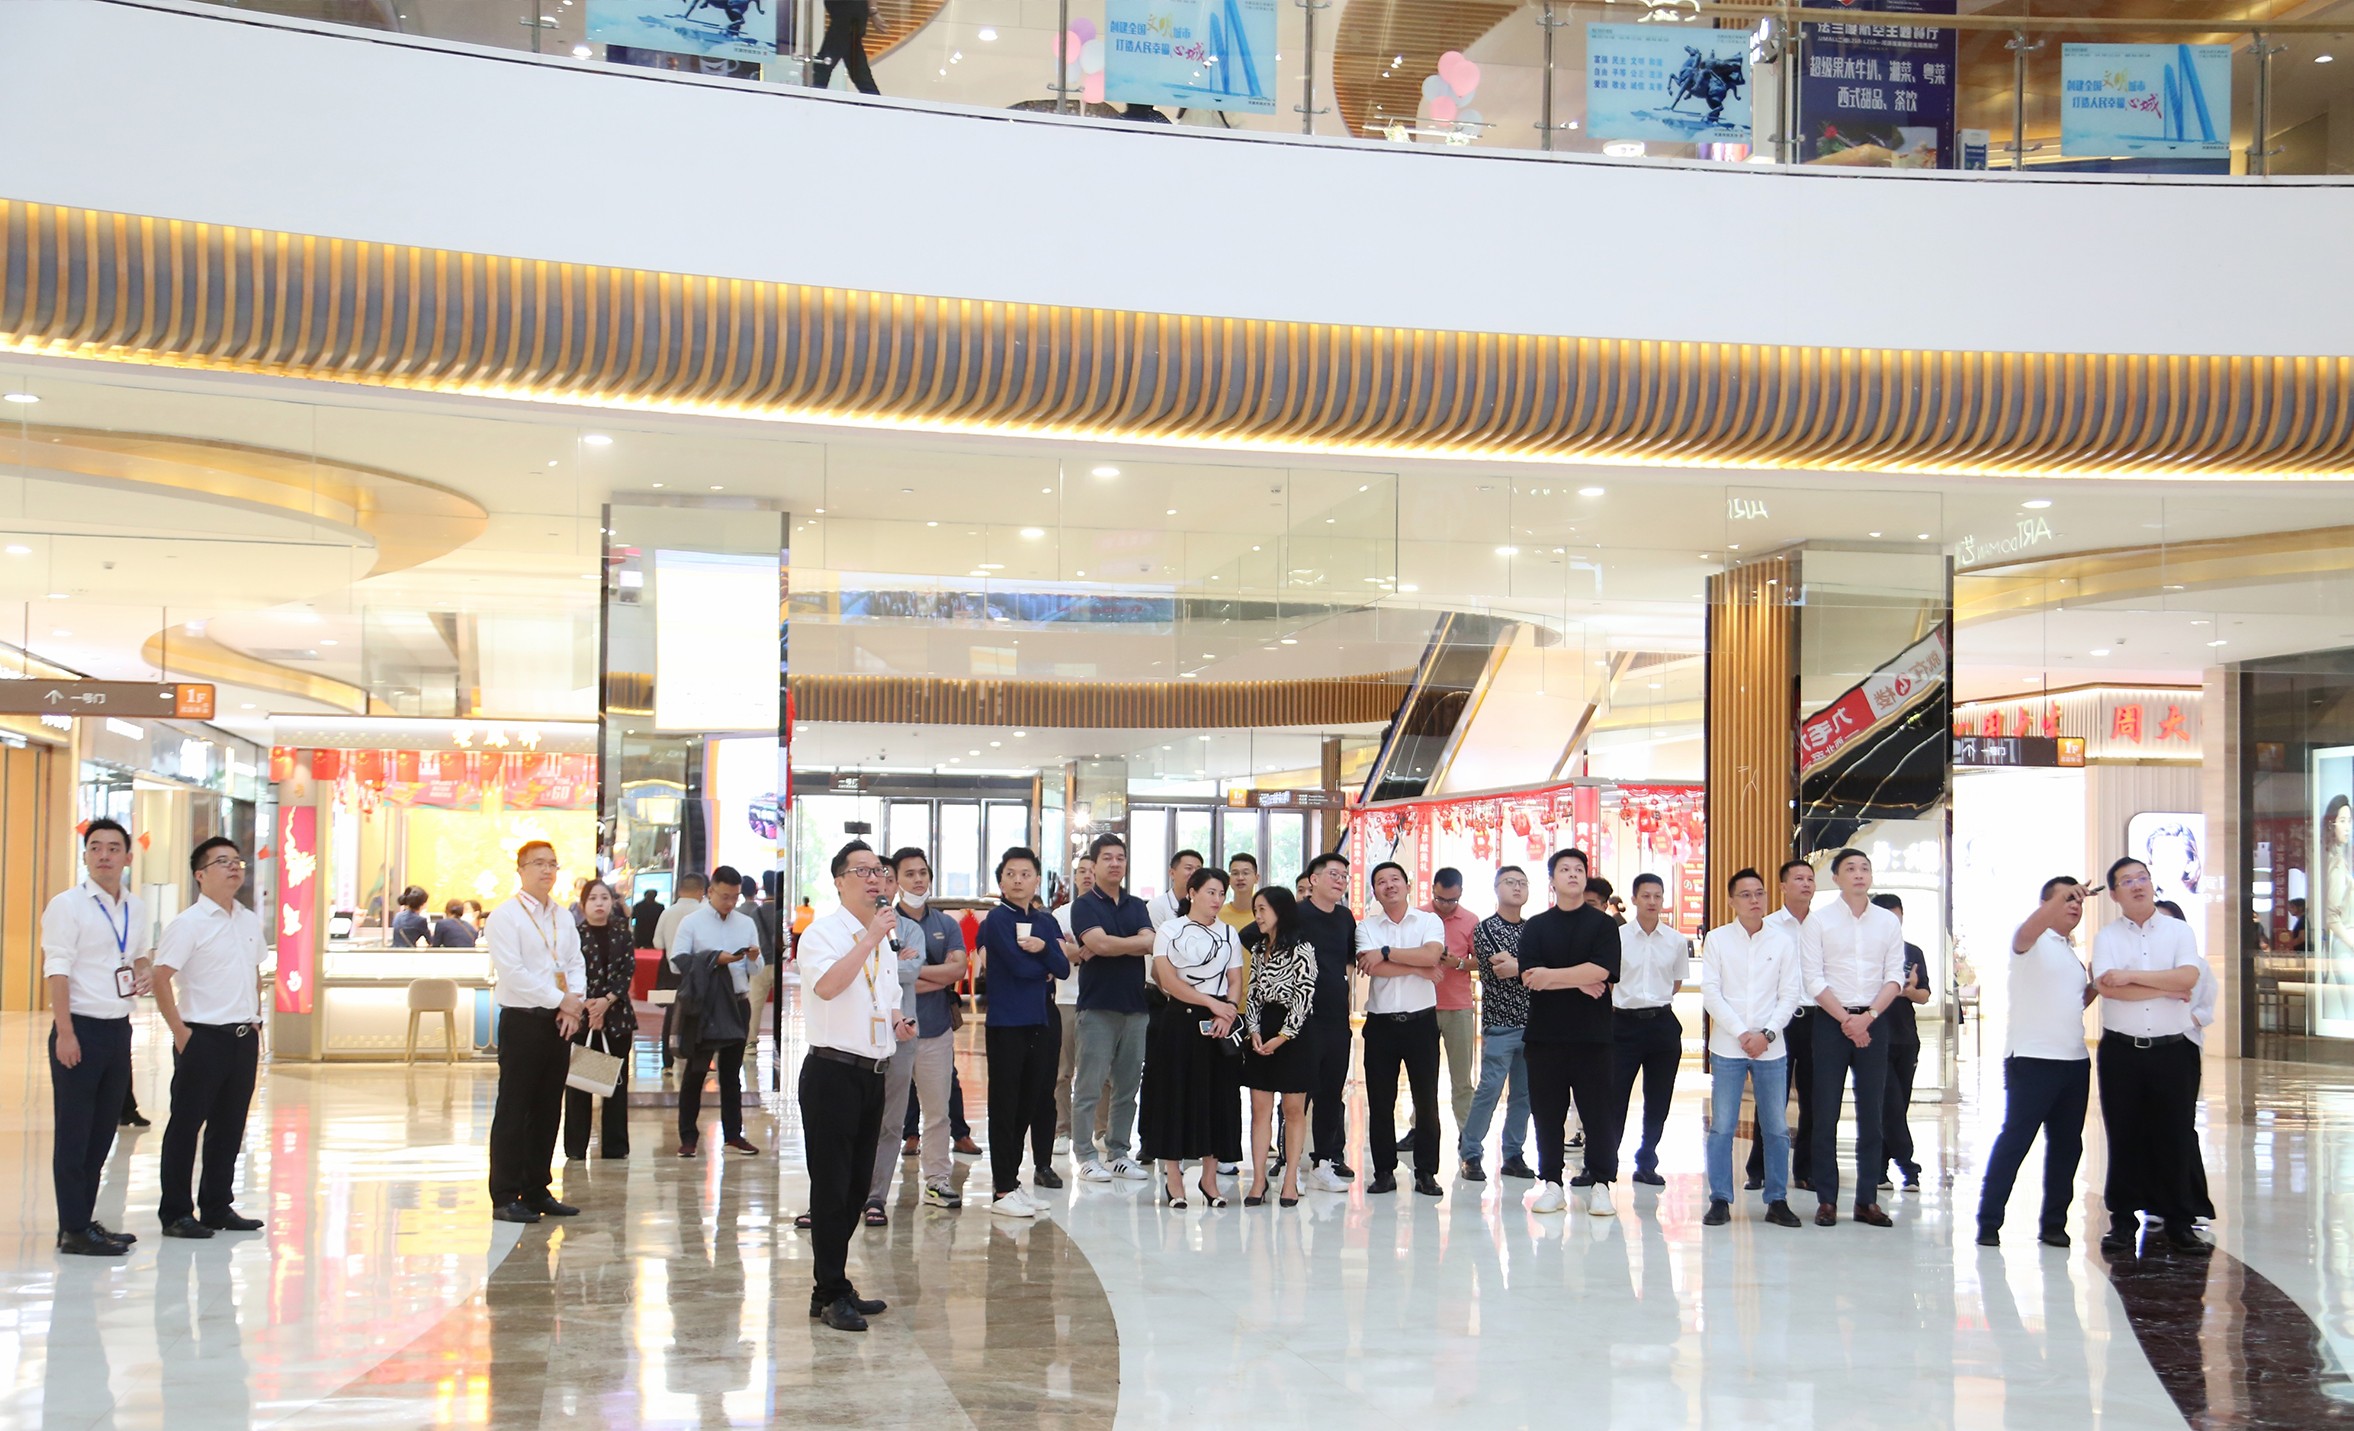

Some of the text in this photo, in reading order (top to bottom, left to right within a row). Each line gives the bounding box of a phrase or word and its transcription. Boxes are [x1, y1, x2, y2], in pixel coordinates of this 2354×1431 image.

[1110, 12, 1191, 39] 创建全国文明城市
[70, 693, 106, 704] 一号门
[186, 688, 206, 704] 1F
[2112, 703, 2191, 744] 周大
